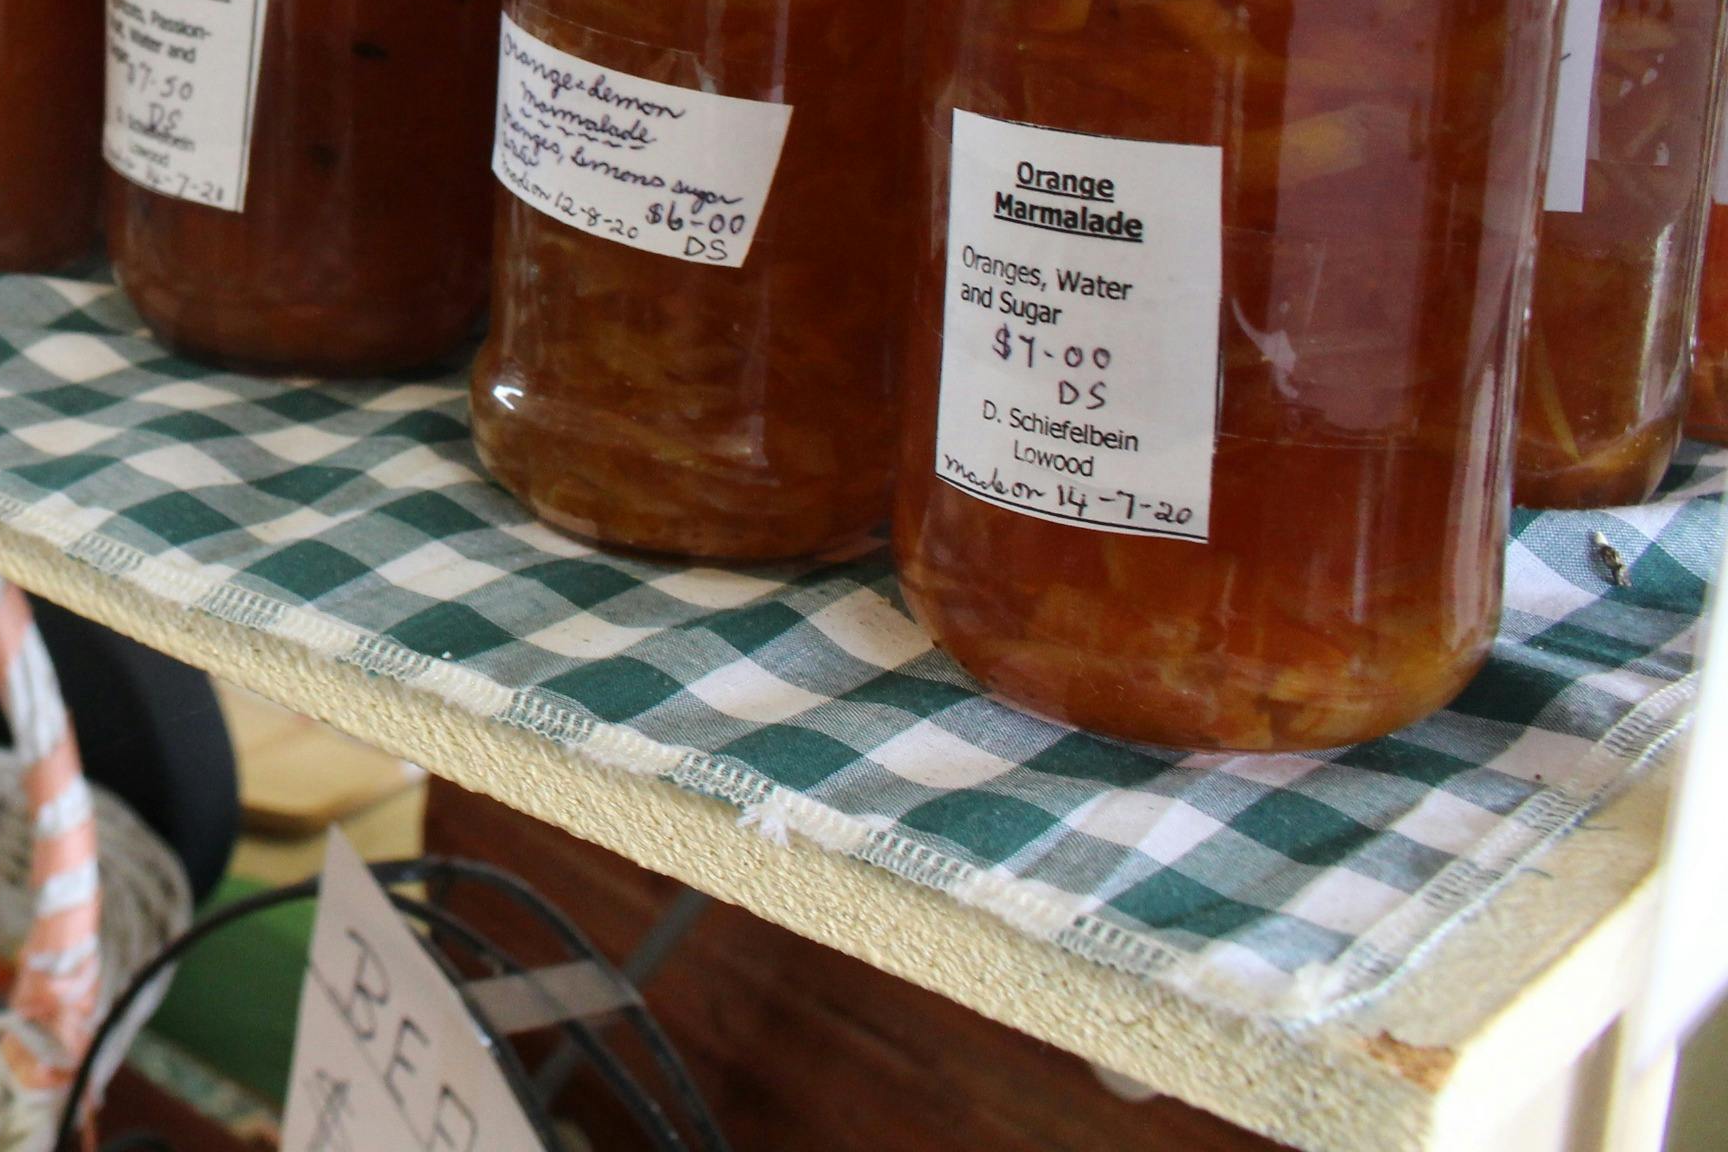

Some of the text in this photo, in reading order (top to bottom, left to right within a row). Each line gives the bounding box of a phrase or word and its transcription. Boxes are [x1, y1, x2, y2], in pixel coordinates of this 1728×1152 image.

[1016, 160, 1116, 201] Orange
[994, 190, 1144, 240] Marmalade
[683, 235, 729, 261] DS
[962, 244, 1134, 301] Oranges, Water
[960, 281, 1064, 326] and Sugar
[982, 399, 1139, 452] D. Schiefelbein
[1013, 439, 1095, 478] Lowood
